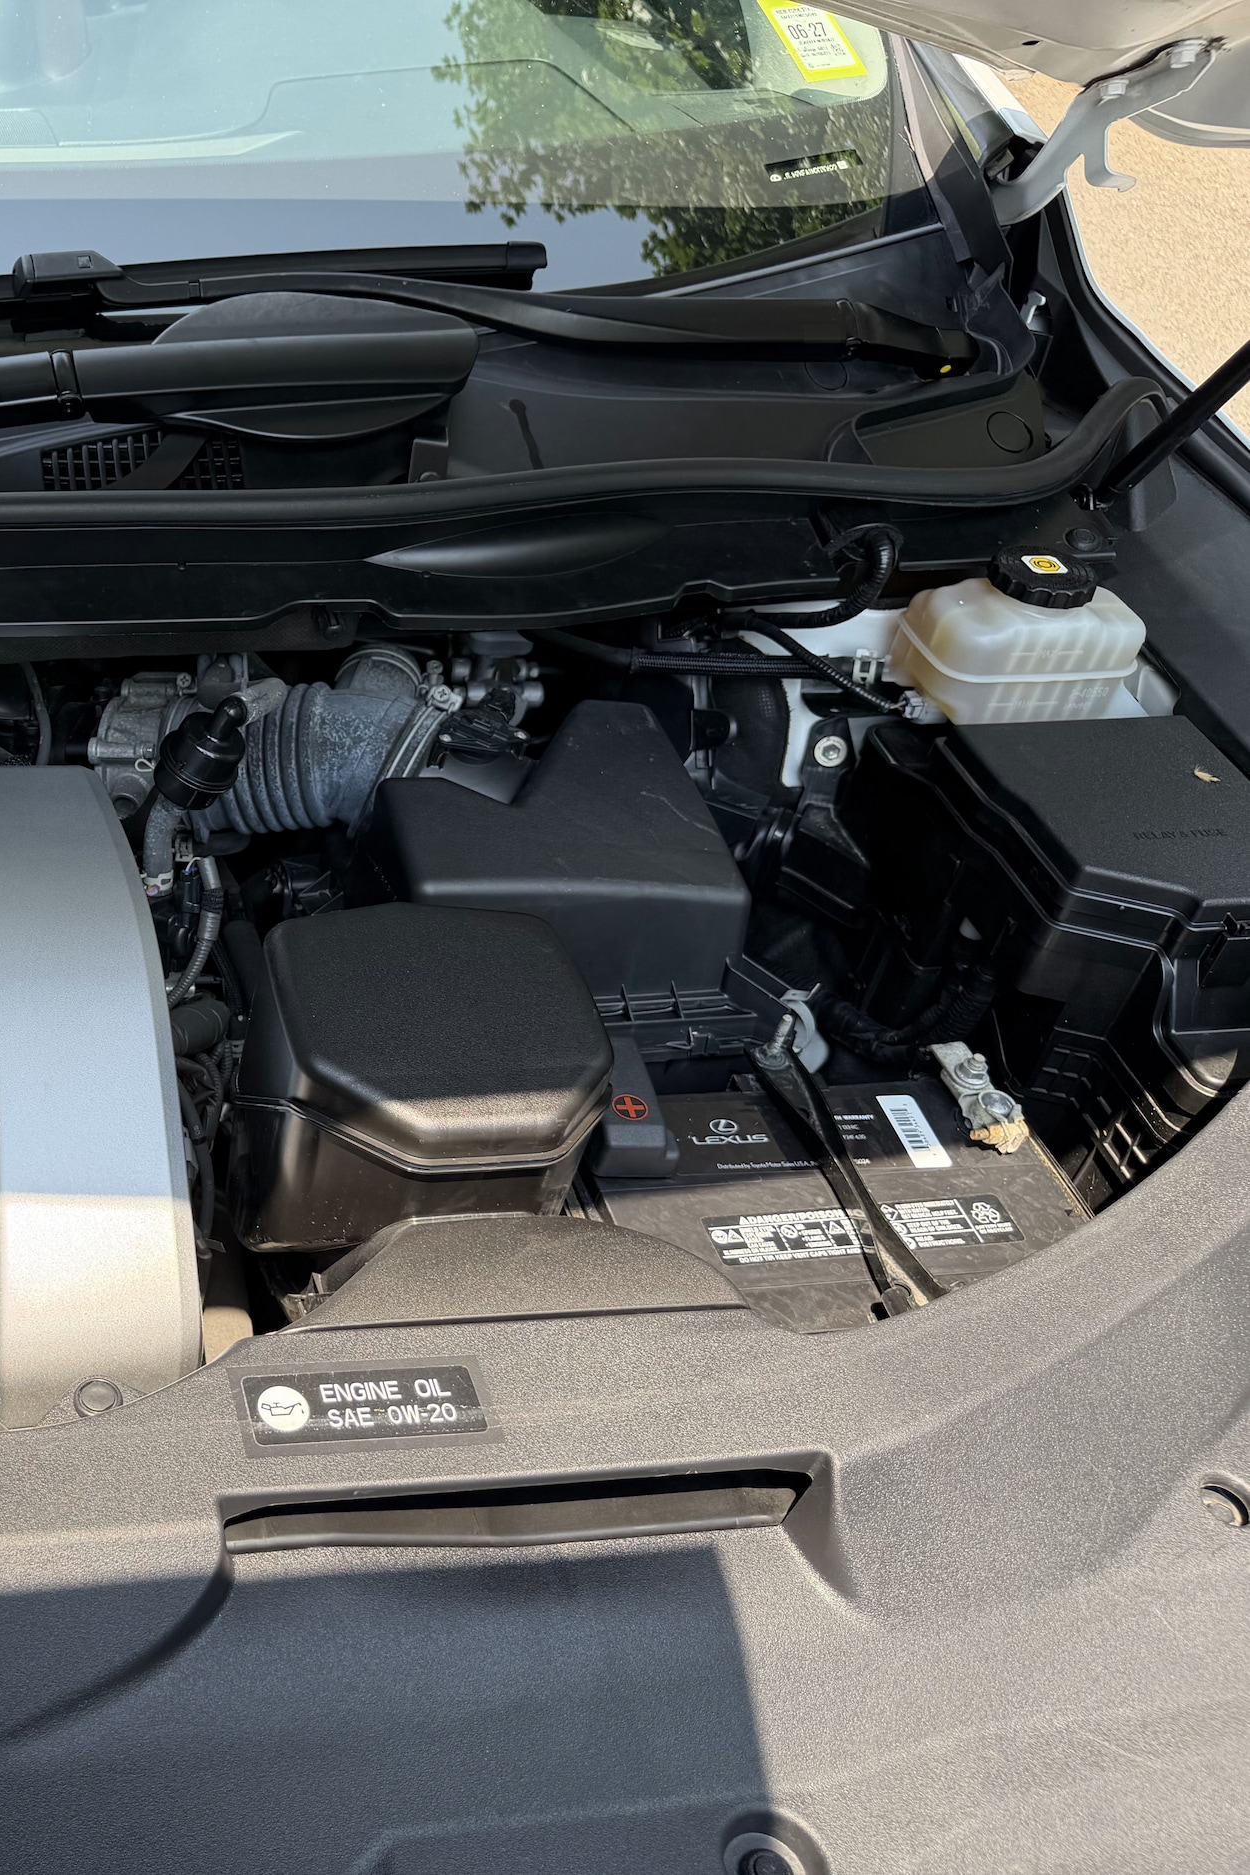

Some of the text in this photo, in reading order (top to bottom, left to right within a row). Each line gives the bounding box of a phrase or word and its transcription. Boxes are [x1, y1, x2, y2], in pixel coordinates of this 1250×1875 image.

[1132, 830, 1177, 840] RELAY
[1190, 828, 1229, 838] FUSE
[692, 1133, 769, 1145] LEXUS
[318, 1378, 452, 1404] ENGINE OIL
[326, 1403, 458, 1429] SAE 0W-20
